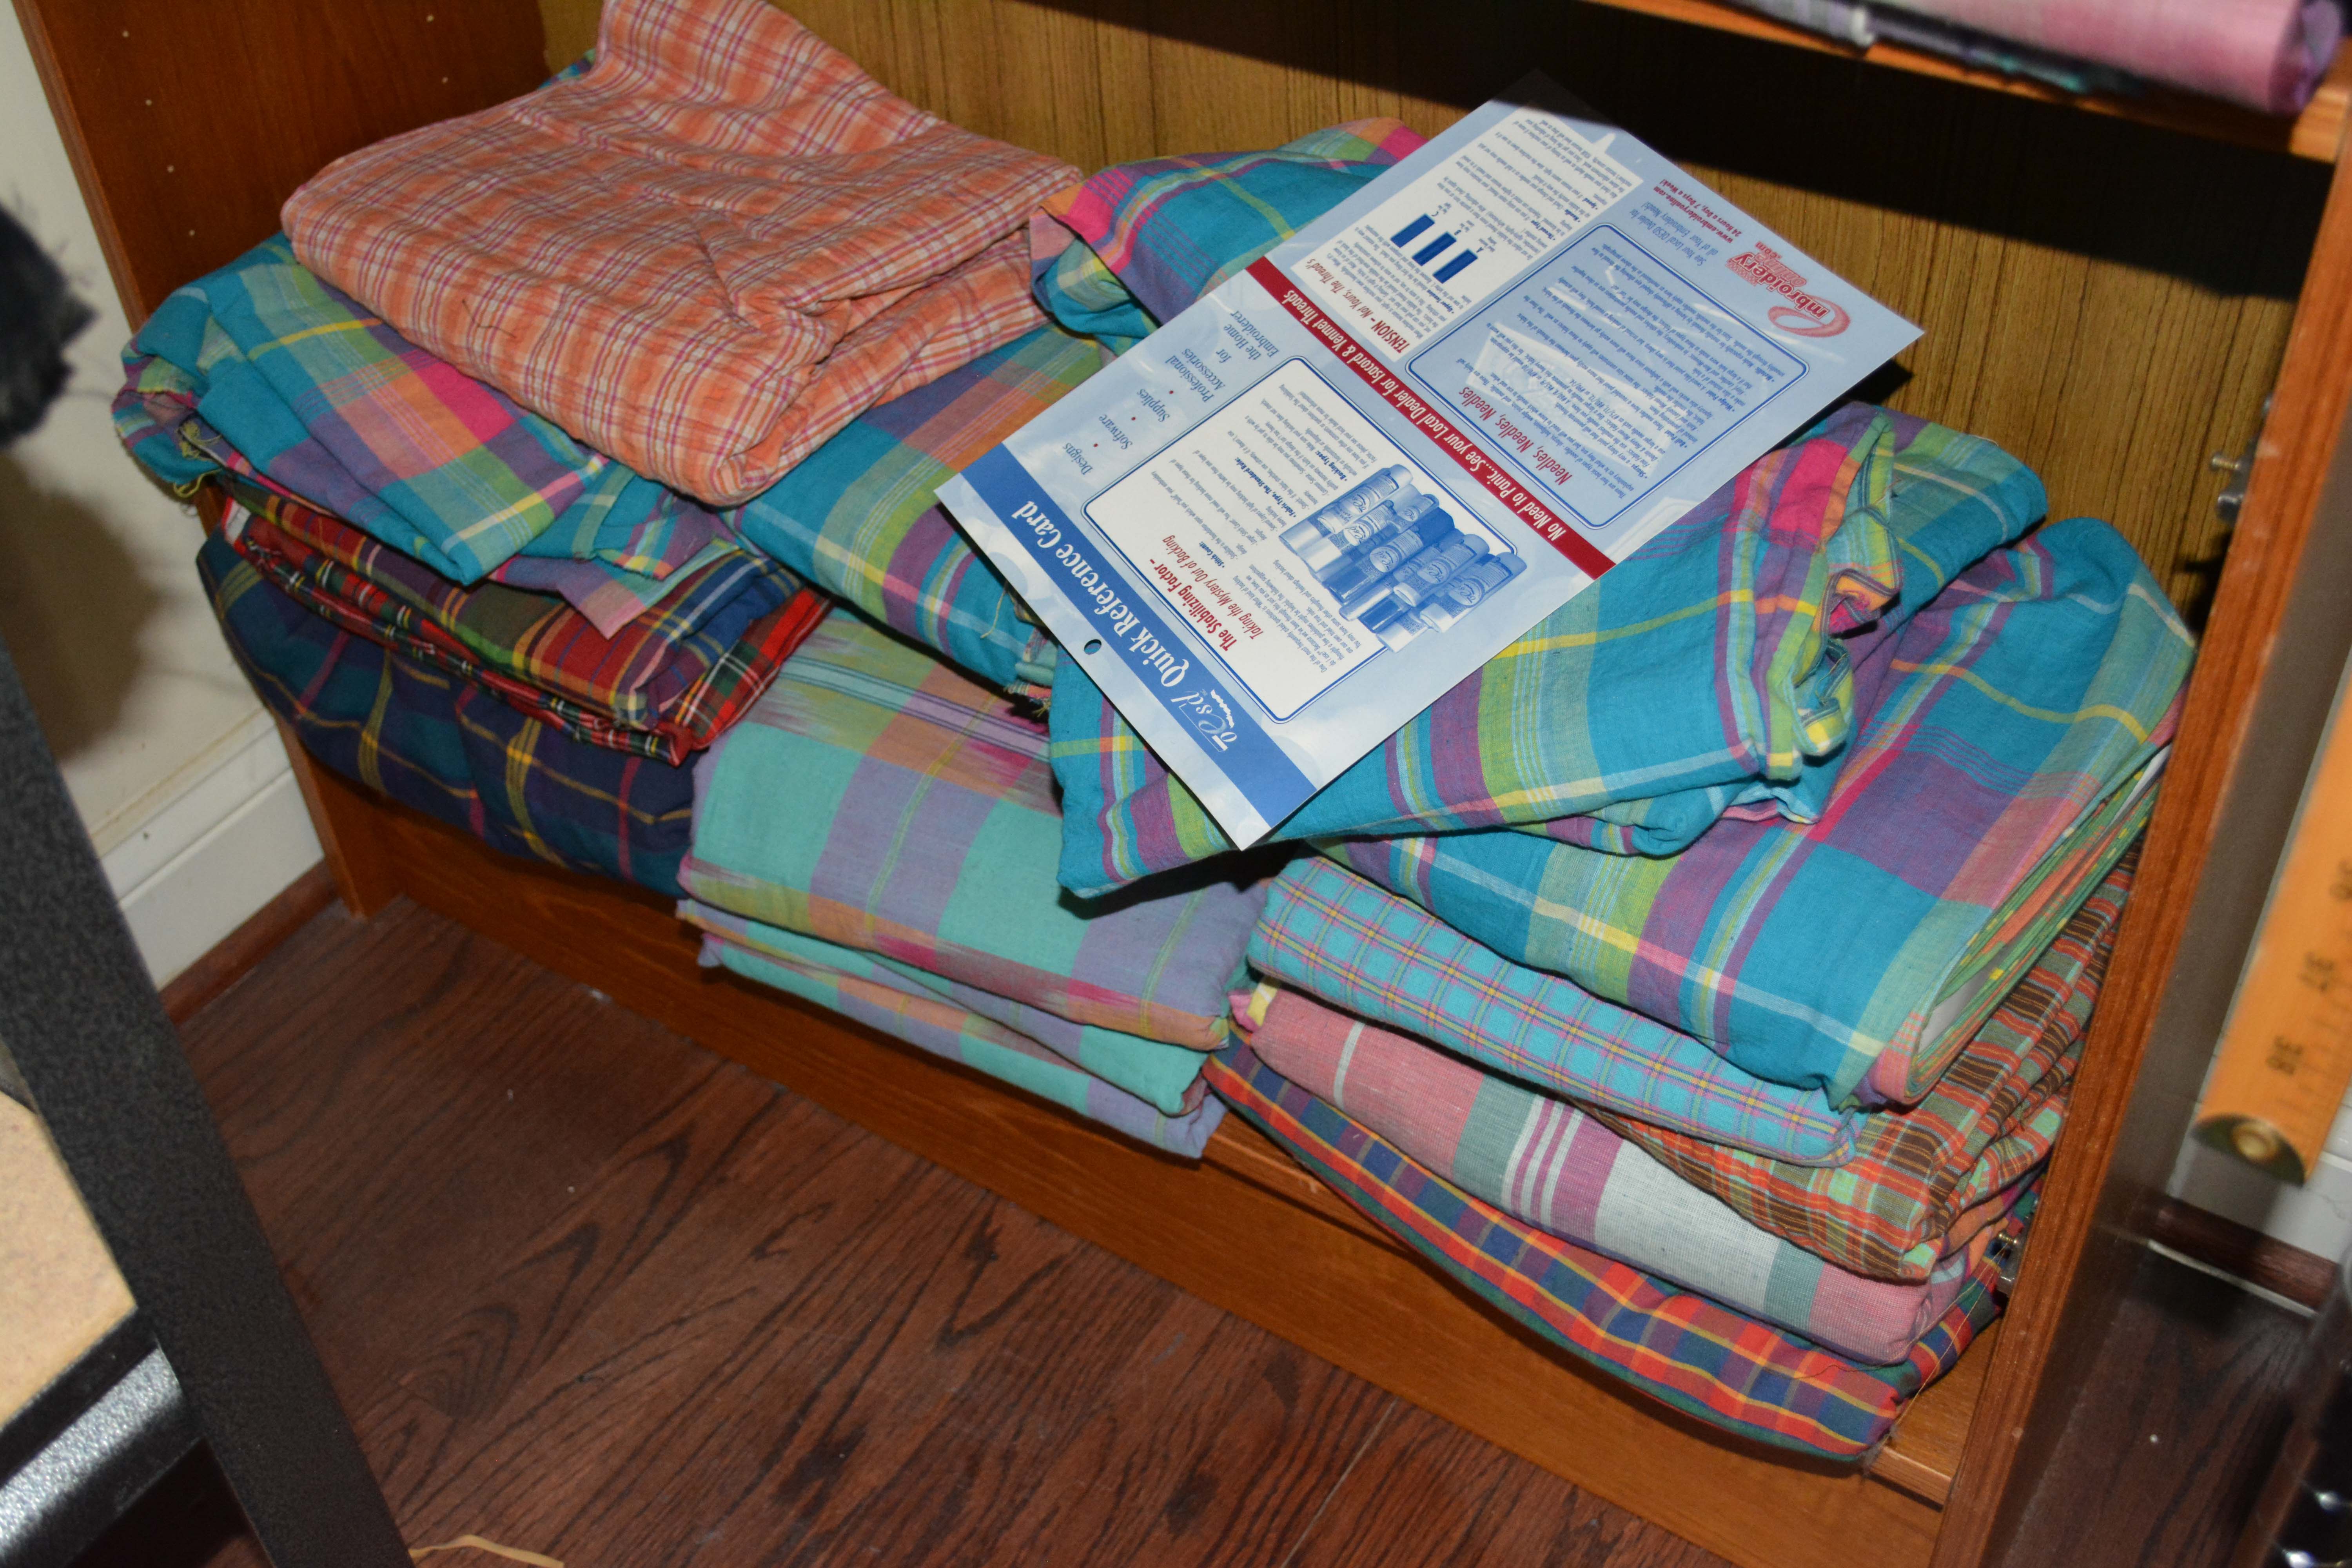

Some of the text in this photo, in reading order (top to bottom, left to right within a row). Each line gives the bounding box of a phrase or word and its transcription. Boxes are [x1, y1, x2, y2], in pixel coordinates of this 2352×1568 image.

[1659, 179, 1679, 193] Week!
[1681, 193, 1697, 205] Days
[1641, 201, 1662, 218] Needs!
[1652, 185, 1734, 243] www.embroideryonline.com
[1659, 212, 1691, 237] Embroidery
[1700, 205, 1714, 217] Day,
[1716, 218, 1734, 231] Hours
[1628, 209, 1707, 266] See Your Local OESD Dealer for
[1689, 234, 1704, 247] Your
[1731, 229, 1742, 237] 24
[1705, 247, 1719, 256] all
[1305, 258, 1373, 318] Not Yours, The Thread's
[1276, 290, 1319, 325] Threads
[1222, 324, 1261, 360] the Home
[1229, 310, 1280, 358] Embroiderer
[1310, 318, 1348, 351] Yenmet
[1371, 320, 1410, 353] TENSION
[1214, 348, 1232, 363] for
[1341, 344, 1356, 357] &
[1164, 355, 1214, 402] Professional
[1180, 348, 1226, 390] Accessories
[1346, 352, 1385, 384] Isacord
[1378, 378, 1399, 396] for
[1135, 388, 1171, 422] Supplies
[1392, 389, 1426, 419] Dealer
[1097, 414, 1133, 450] Software
[1416, 413, 1449, 439] Local
[1457, 387, 1573, 486] Needles, Needles, Needles
[1443, 432, 1473, 454] your
[1062, 442, 1094, 475] Designs
[1314, 450, 1347, 480] Backing Types:
[1234, 457, 1295, 516] Fabric Type, The Standard Rule:
[1511, 492, 1527, 506] to
[1517, 501, 1552, 529] Need
[1546, 523, 1566, 541] No
[1198, 541, 1224, 566] Stitch Count:
[1011, 500, 1191, 688] Quick Reference Card
[1161, 534, 1264, 640] Taking the Mystery Out of Backing
[1152, 563, 1237, 651] The Stabilizing Factor
